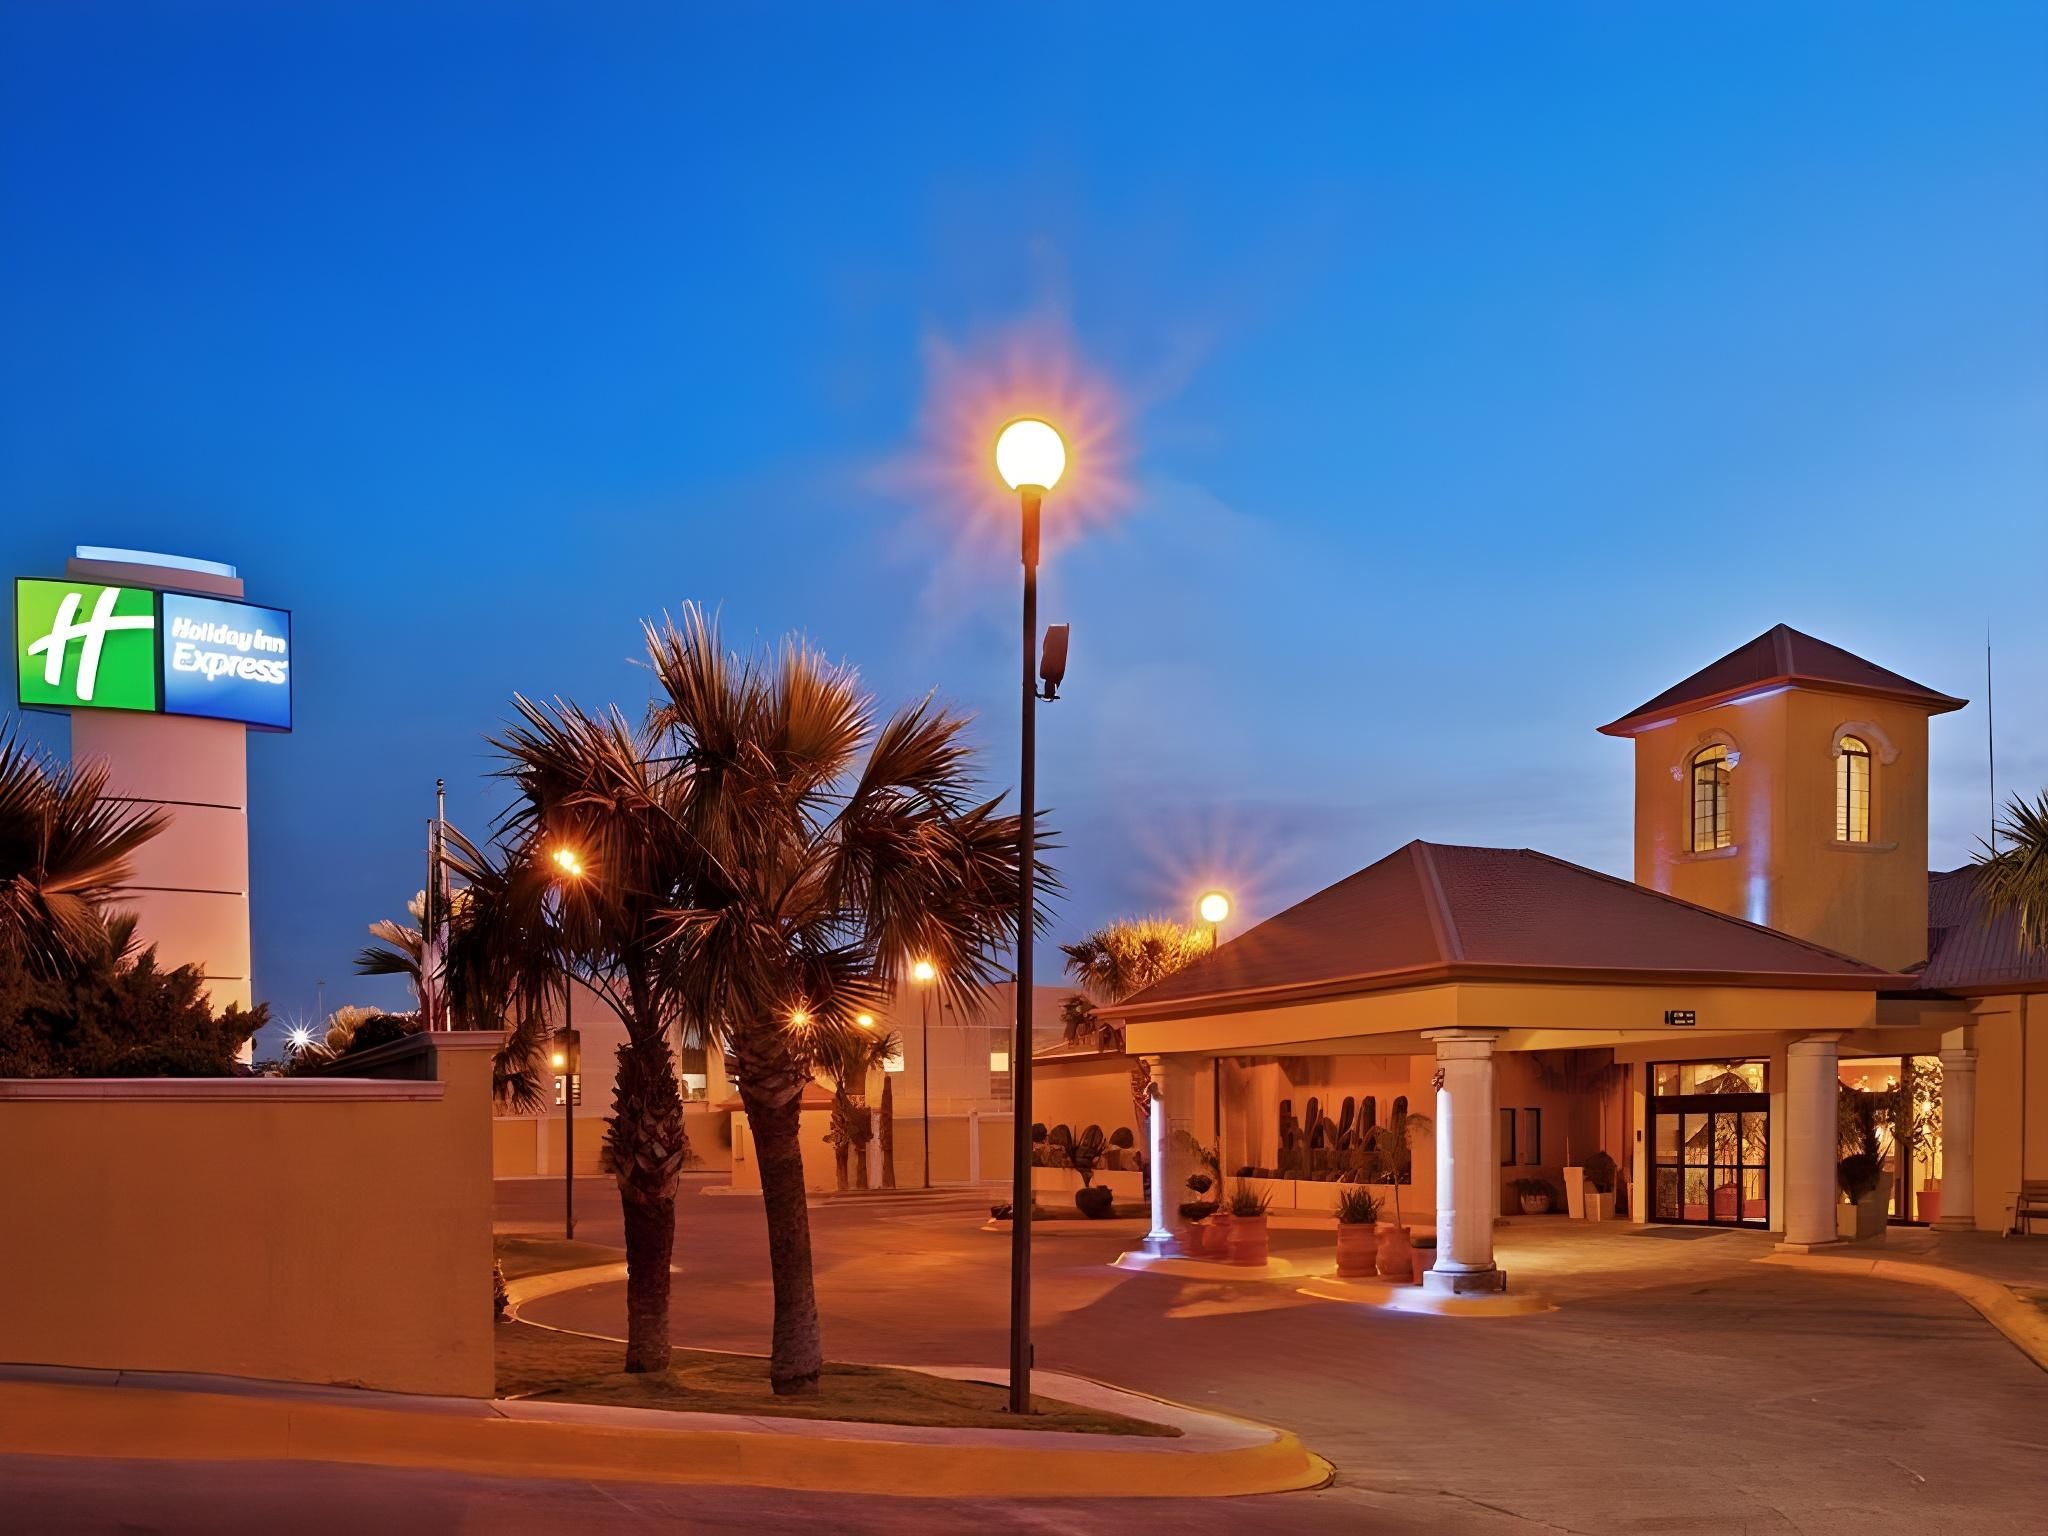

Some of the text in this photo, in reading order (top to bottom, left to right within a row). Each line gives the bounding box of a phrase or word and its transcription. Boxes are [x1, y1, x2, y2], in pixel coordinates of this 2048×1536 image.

[172, 617, 286, 653] Holiday Inn
[172, 642, 289, 684] Express
